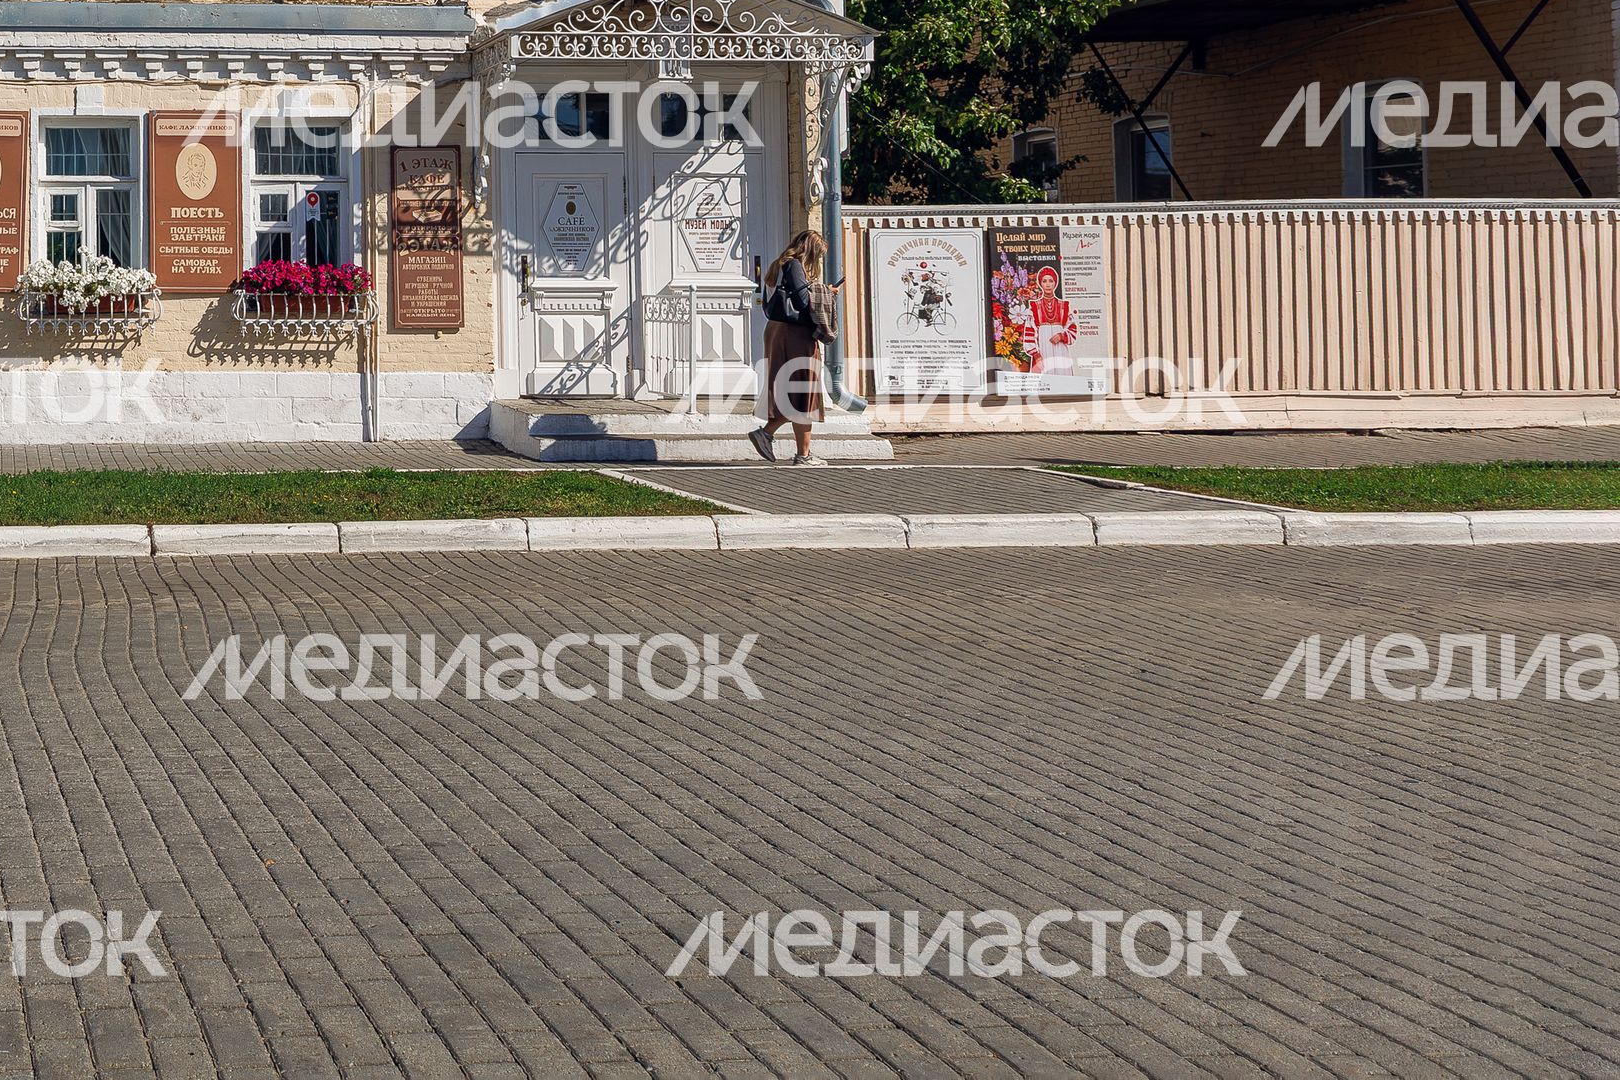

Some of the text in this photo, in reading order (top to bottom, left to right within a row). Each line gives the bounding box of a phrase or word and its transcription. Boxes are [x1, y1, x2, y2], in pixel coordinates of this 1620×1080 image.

[400, 158, 453, 172] 1 ЭТАЖ
[409, 175, 445, 184] КАФЕ
[170, 208, 224, 218] ПОЕСТЬ
[170, 226, 226, 234] ПОЛЕЗНЫЕ
[171, 234, 225, 242] ЗАВТРАКИ
[996, 232, 1046, 244] Целый мир
[1062, 232, 1100, 240] Музей моды
[160, 246, 233, 254] СЫТНЫЕ ОБЕДЫ
[887, 238, 968, 268] РОЗНИЧНАЯ ПРОДАЖА
[1030, 246, 1056, 254] руках
[408, 256, 446, 264] МАГАЗИН
[172, 266, 222, 274] НА УГЛЯХ
